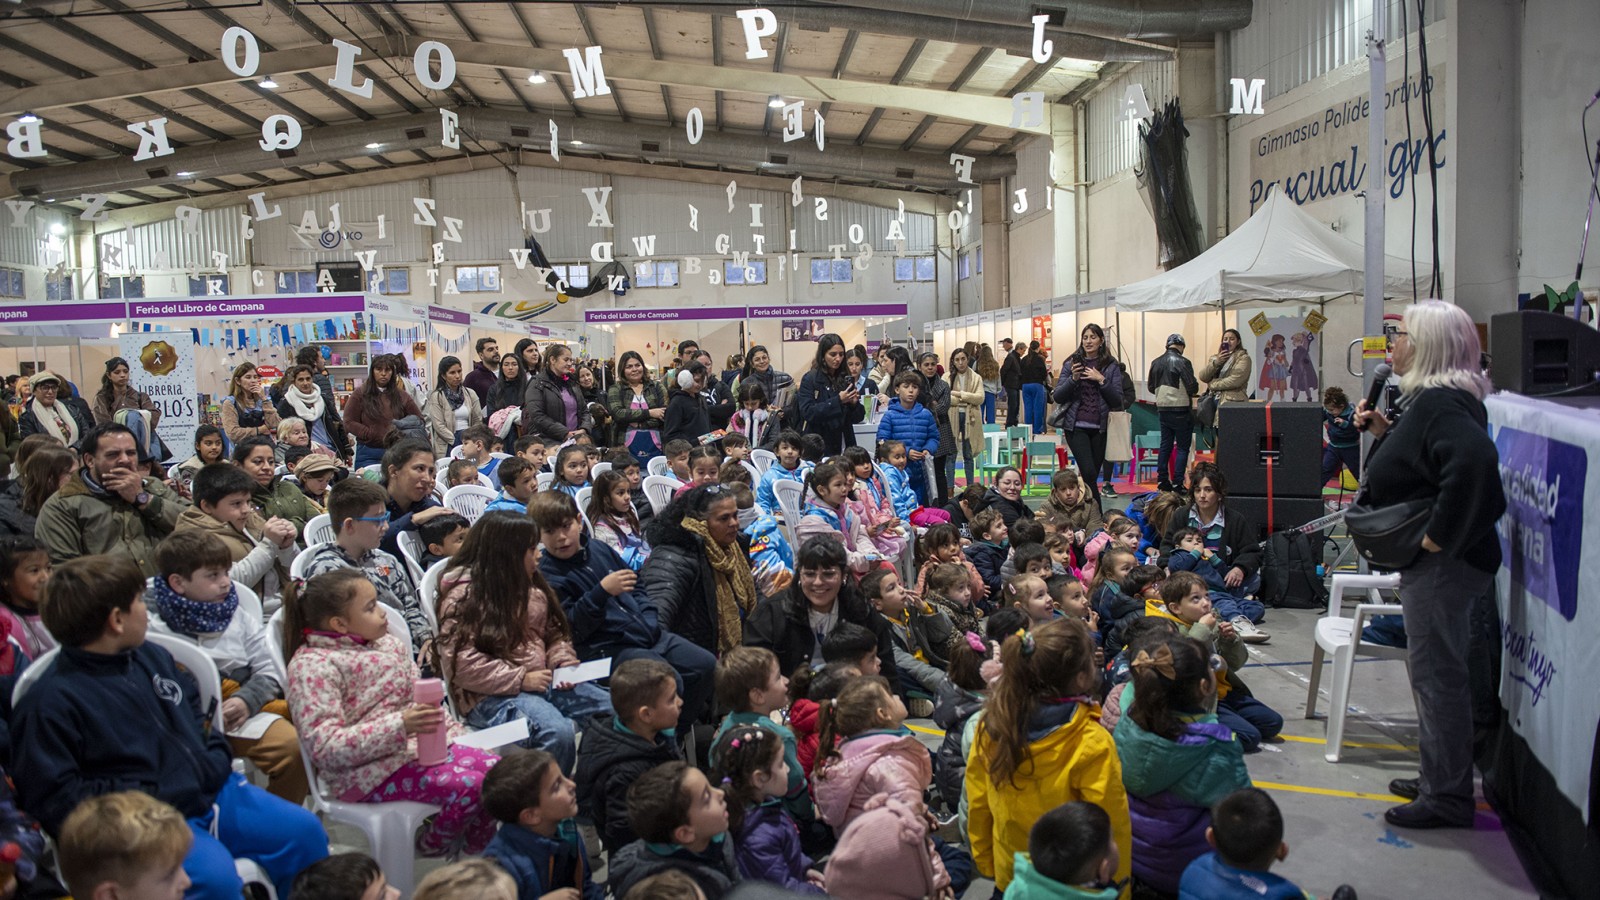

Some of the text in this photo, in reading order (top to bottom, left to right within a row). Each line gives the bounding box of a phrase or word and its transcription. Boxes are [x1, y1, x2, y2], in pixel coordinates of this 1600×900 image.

[220, 26, 260, 77] O
[736, 8, 778, 60] P
[328, 38, 374, 99] L
[413, 41, 457, 90] O
[562, 45, 611, 99] M
[1229, 77, 1266, 115] M
[1258, 74, 1435, 157] Gimnasio Polideortivo
[0, 310, 28, 320] mpana
[135, 302, 265, 315] Feria del Libro de Campana
[647, 311, 679, 319] Campana
[770, 308, 782, 316] del
[809, 308, 841, 316] Campana
